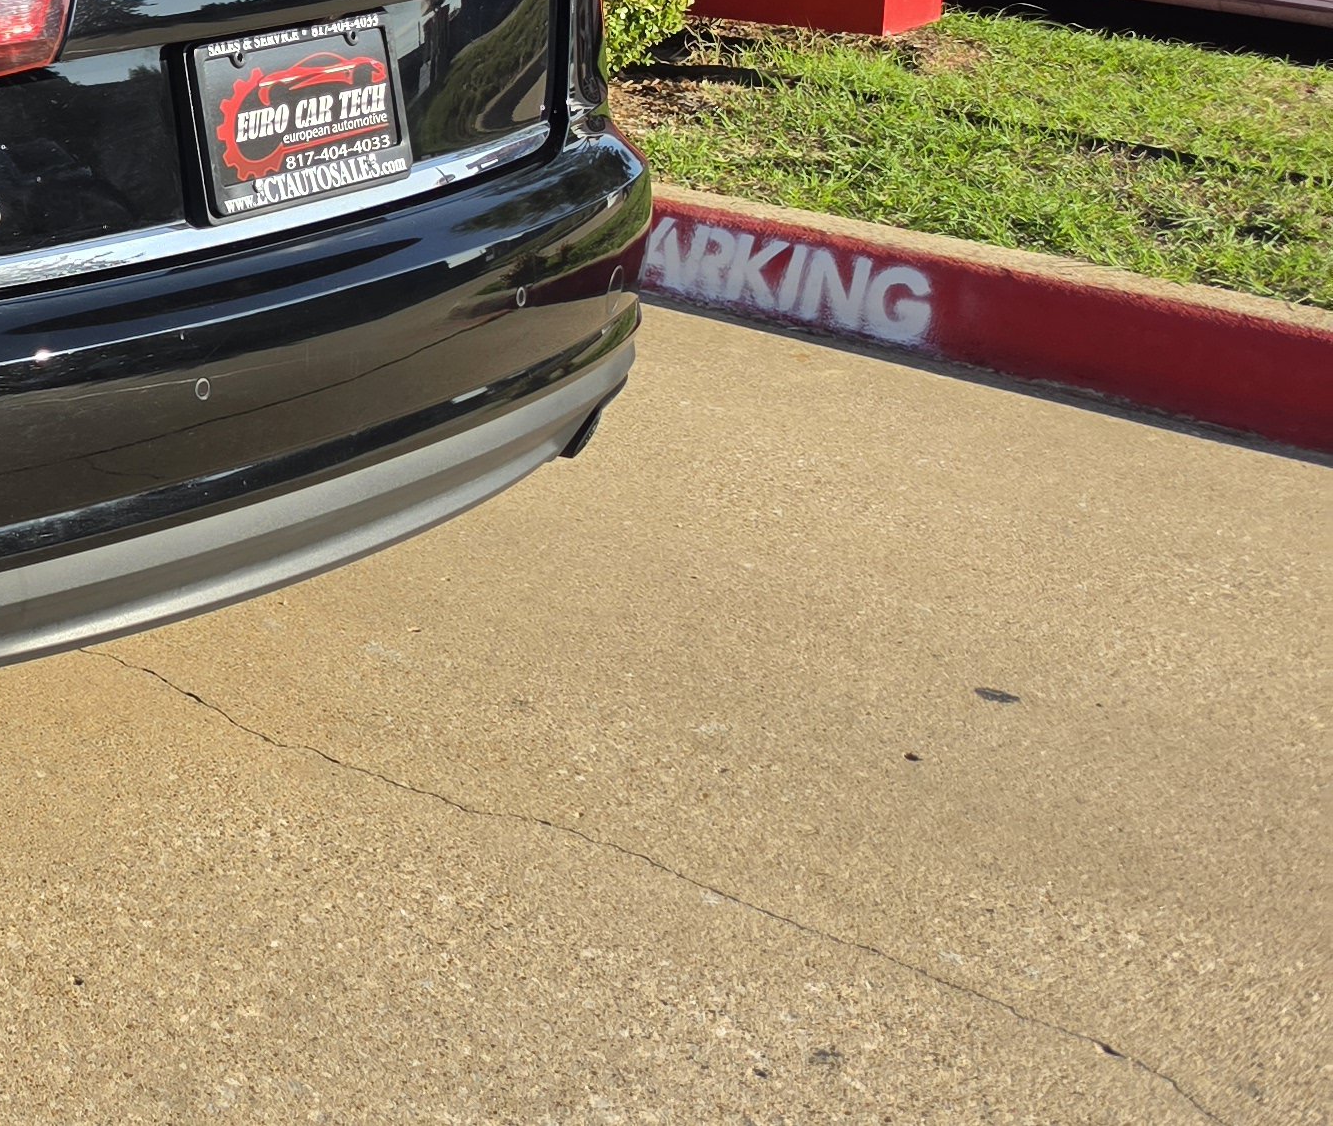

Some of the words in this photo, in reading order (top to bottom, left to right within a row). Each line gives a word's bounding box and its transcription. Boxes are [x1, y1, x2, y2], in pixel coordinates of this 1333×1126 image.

[207, 40, 241, 57] SALES
[243, 38, 252, 51] &
[253, 30, 300, 48] SERVICE
[235, 103, 290, 143] EURO
[294, 96, 334, 128] CAR
[338, 82, 388, 119] TECH
[283, 124, 331, 144] european
[331, 112, 388, 134] automotive
[286, 134, 391, 170] 817-404-4033
[224, 153, 407, 214] www.ECTAUTOSALES.com
[639, 215, 933, 350] ARKING
